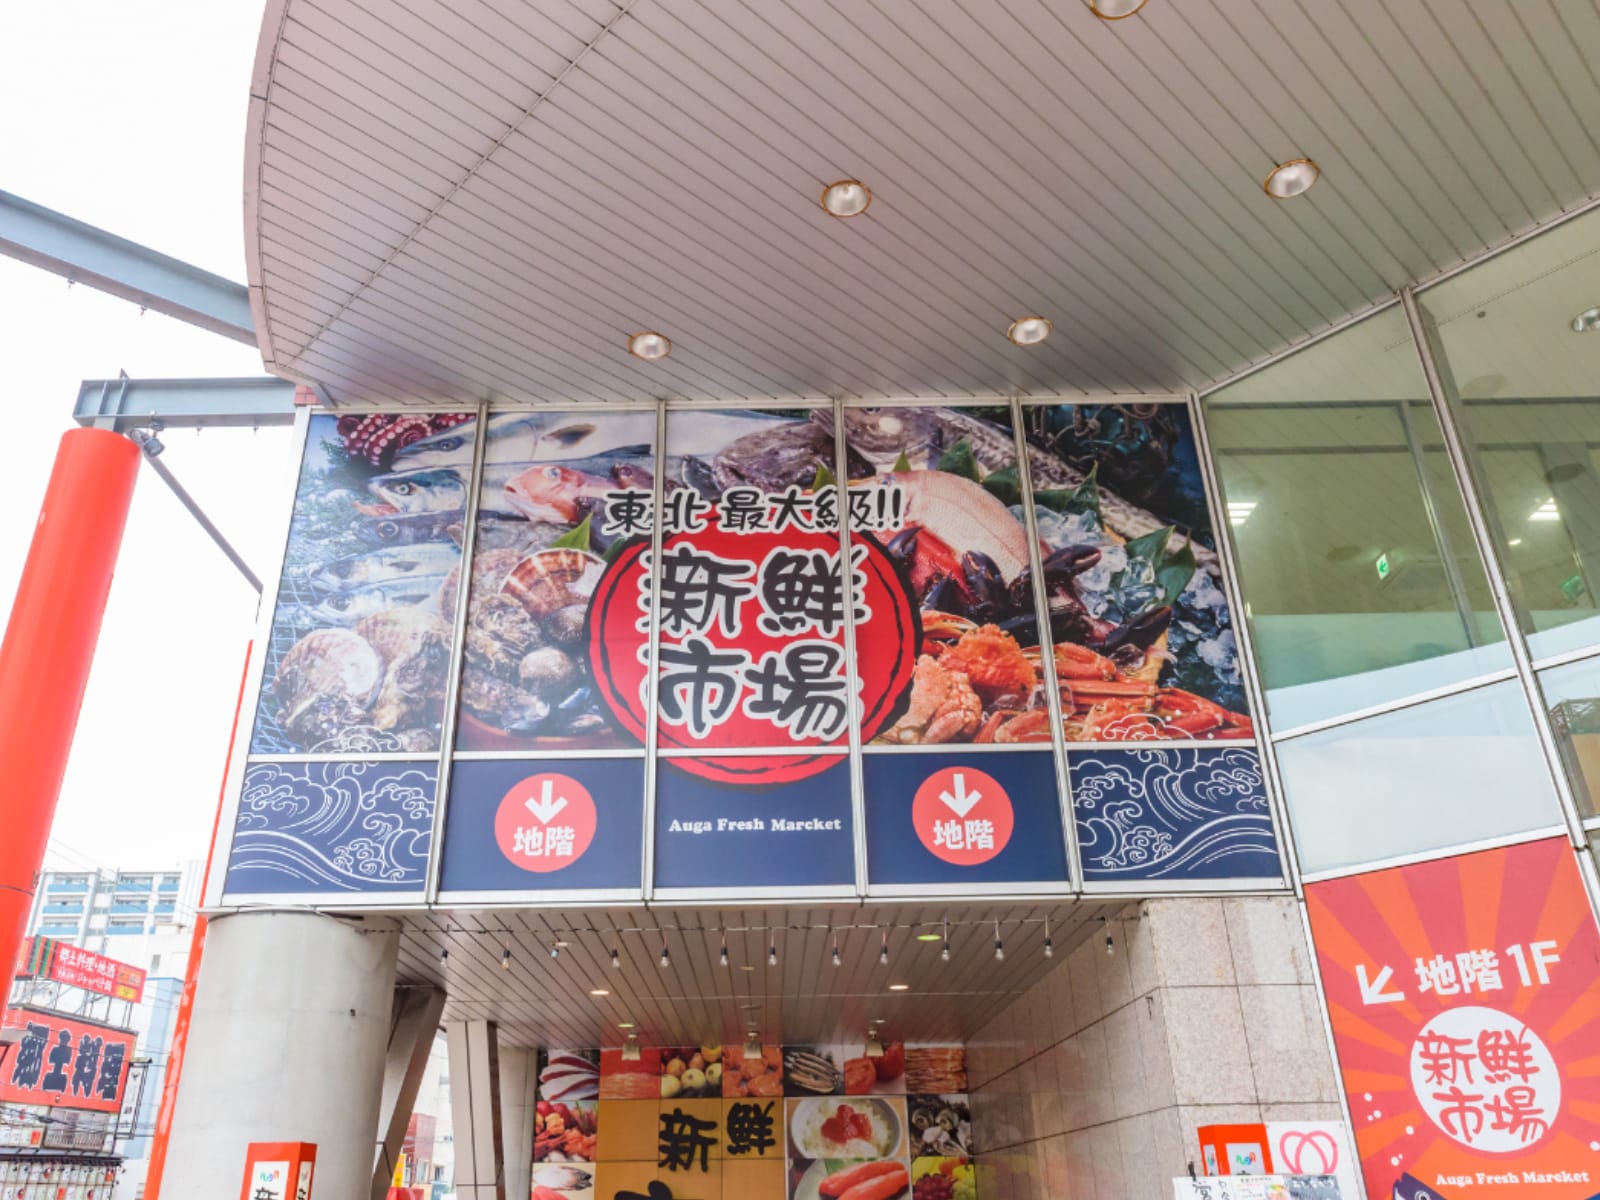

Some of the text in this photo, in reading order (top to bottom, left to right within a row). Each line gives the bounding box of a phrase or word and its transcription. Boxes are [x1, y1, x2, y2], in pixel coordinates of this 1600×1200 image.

[641, 546, 867, 634] 新鮮
[640, 639, 848, 735] 市場
[512, 826, 575, 857] 地階
[668, 818, 842, 834] Auga Fresh Marcket
[932, 819, 995, 850] 地階
[1415, 1025, 1540, 1085] 新鮮
[658, 1101, 776, 1172] 新鮮
[1432, 1086, 1549, 1143] 市場
[1436, 1171, 1590, 1188] Auga Fresh Marcket
